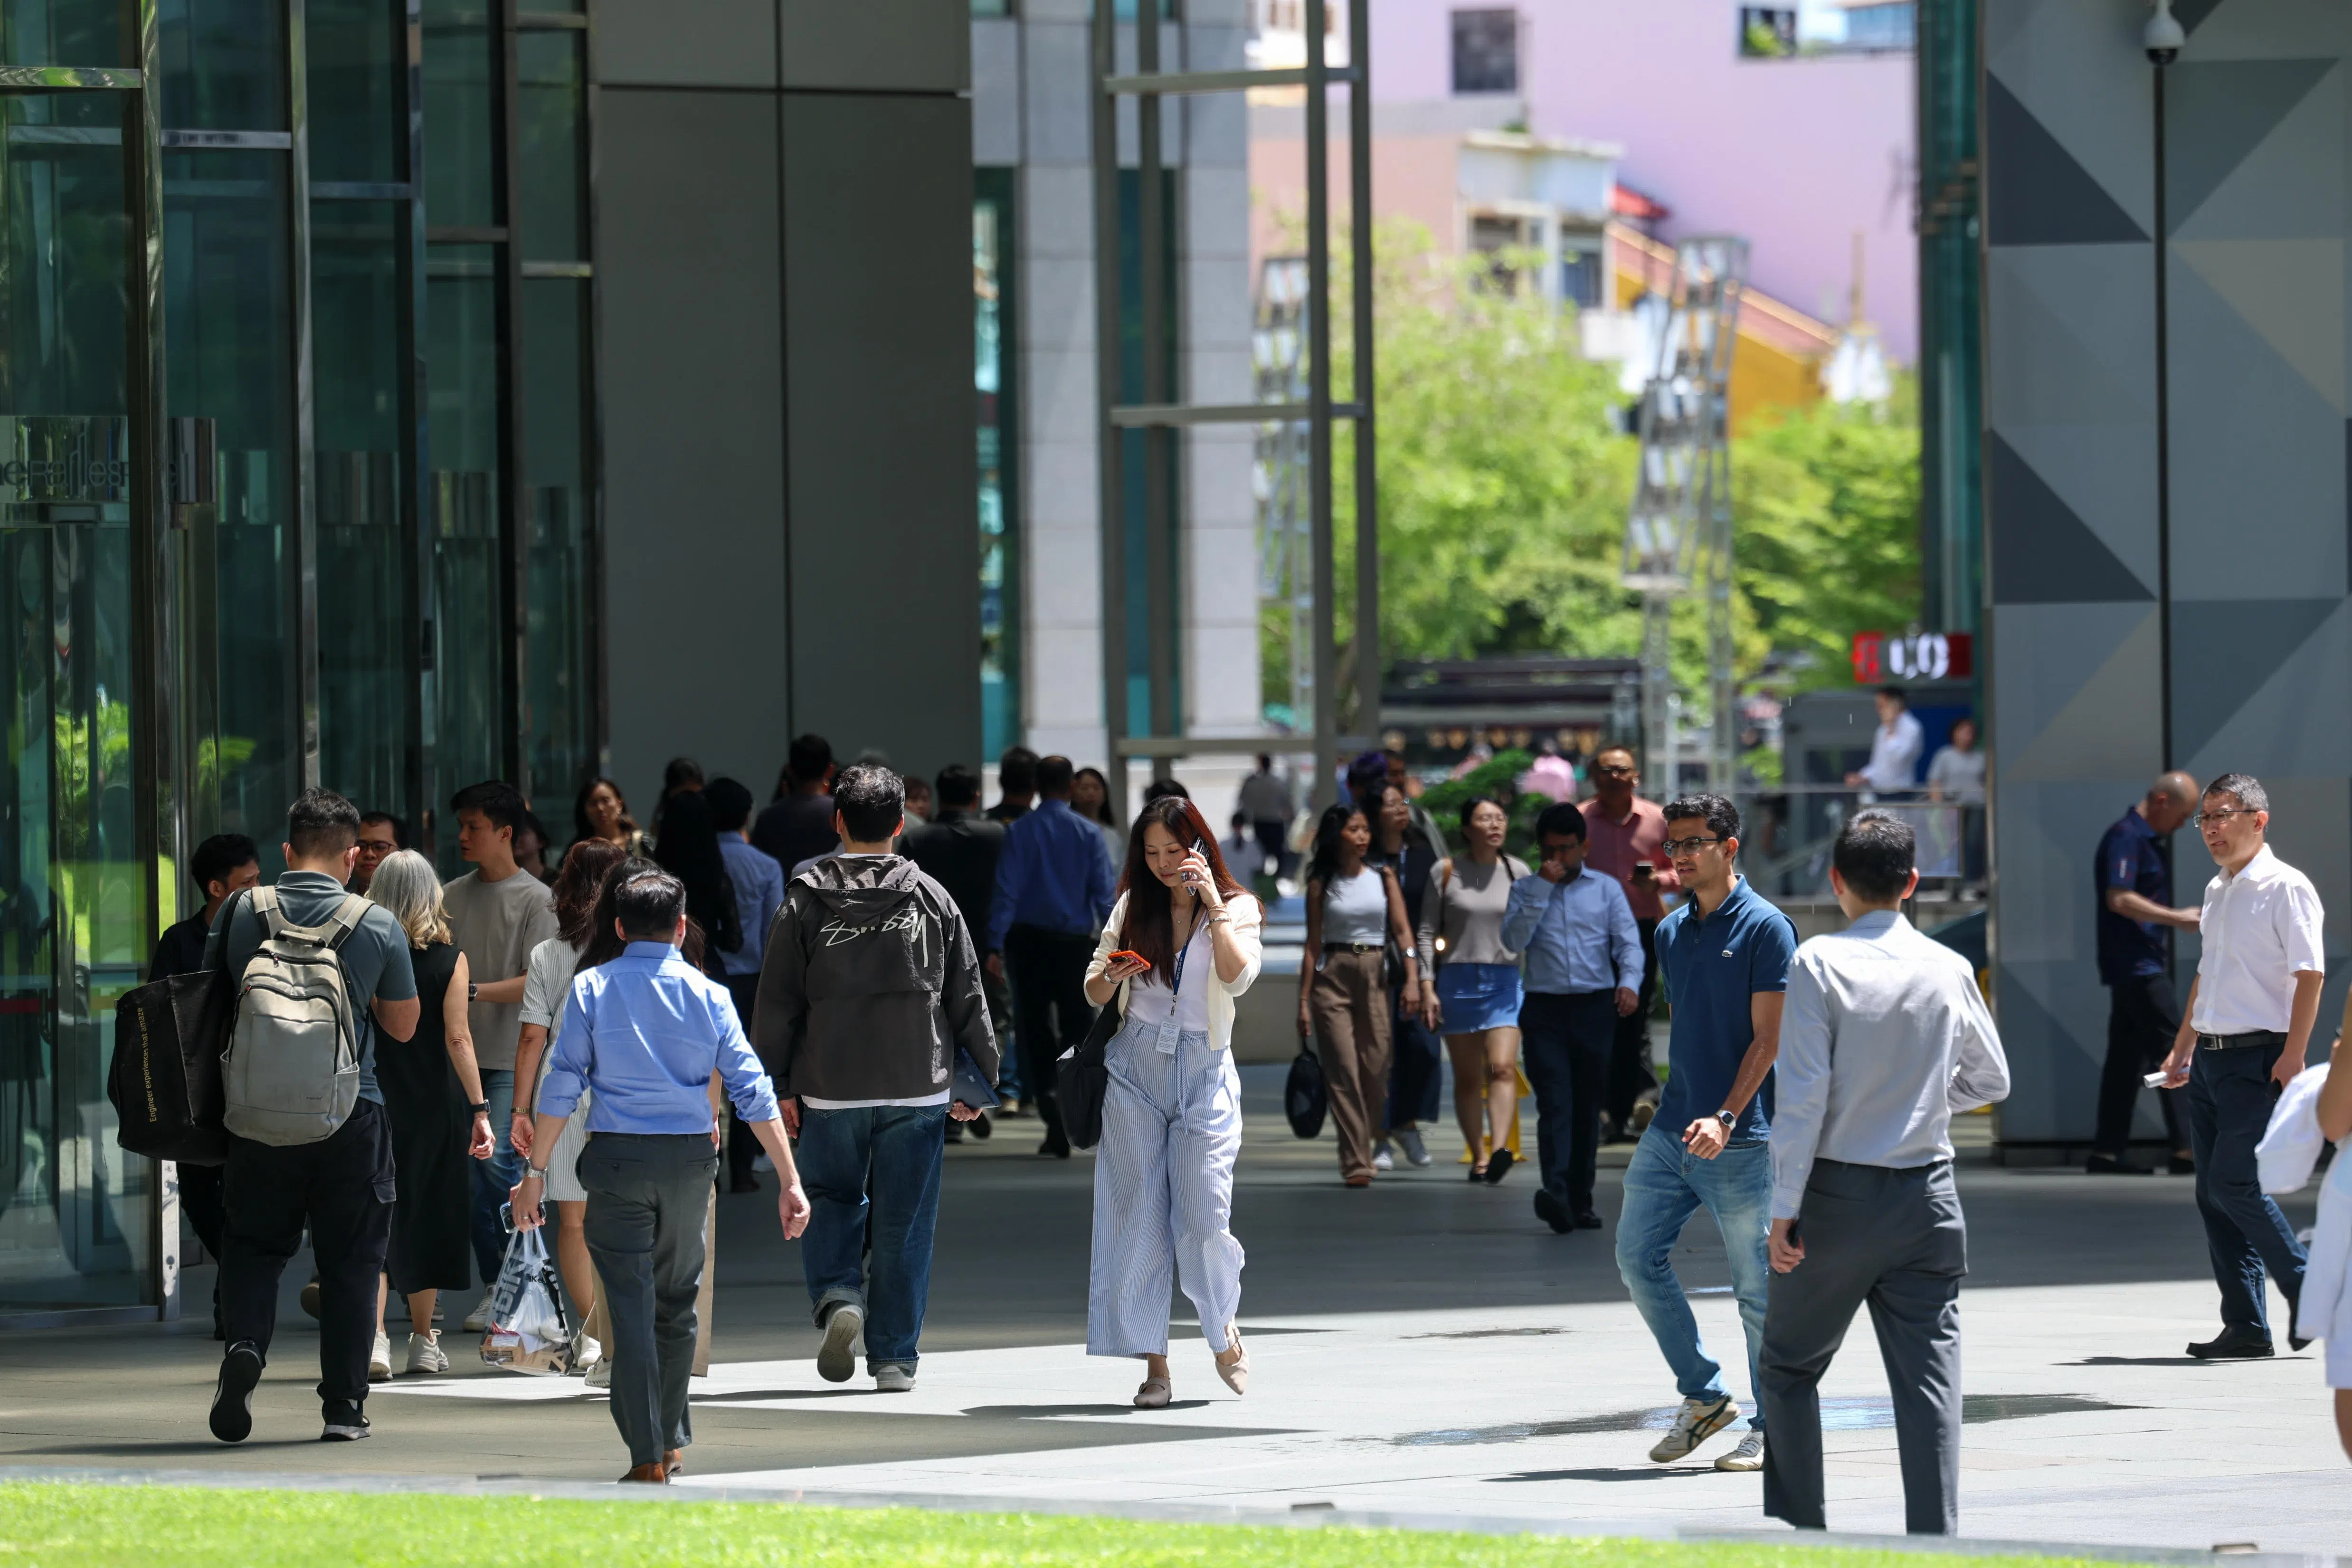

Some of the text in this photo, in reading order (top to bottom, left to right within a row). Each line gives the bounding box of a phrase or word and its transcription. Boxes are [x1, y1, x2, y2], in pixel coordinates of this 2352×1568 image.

[137, 1007, 146, 1032] amaze
[142, 1048, 152, 1089] experiences
[147, 1090, 157, 1122] Engineer
